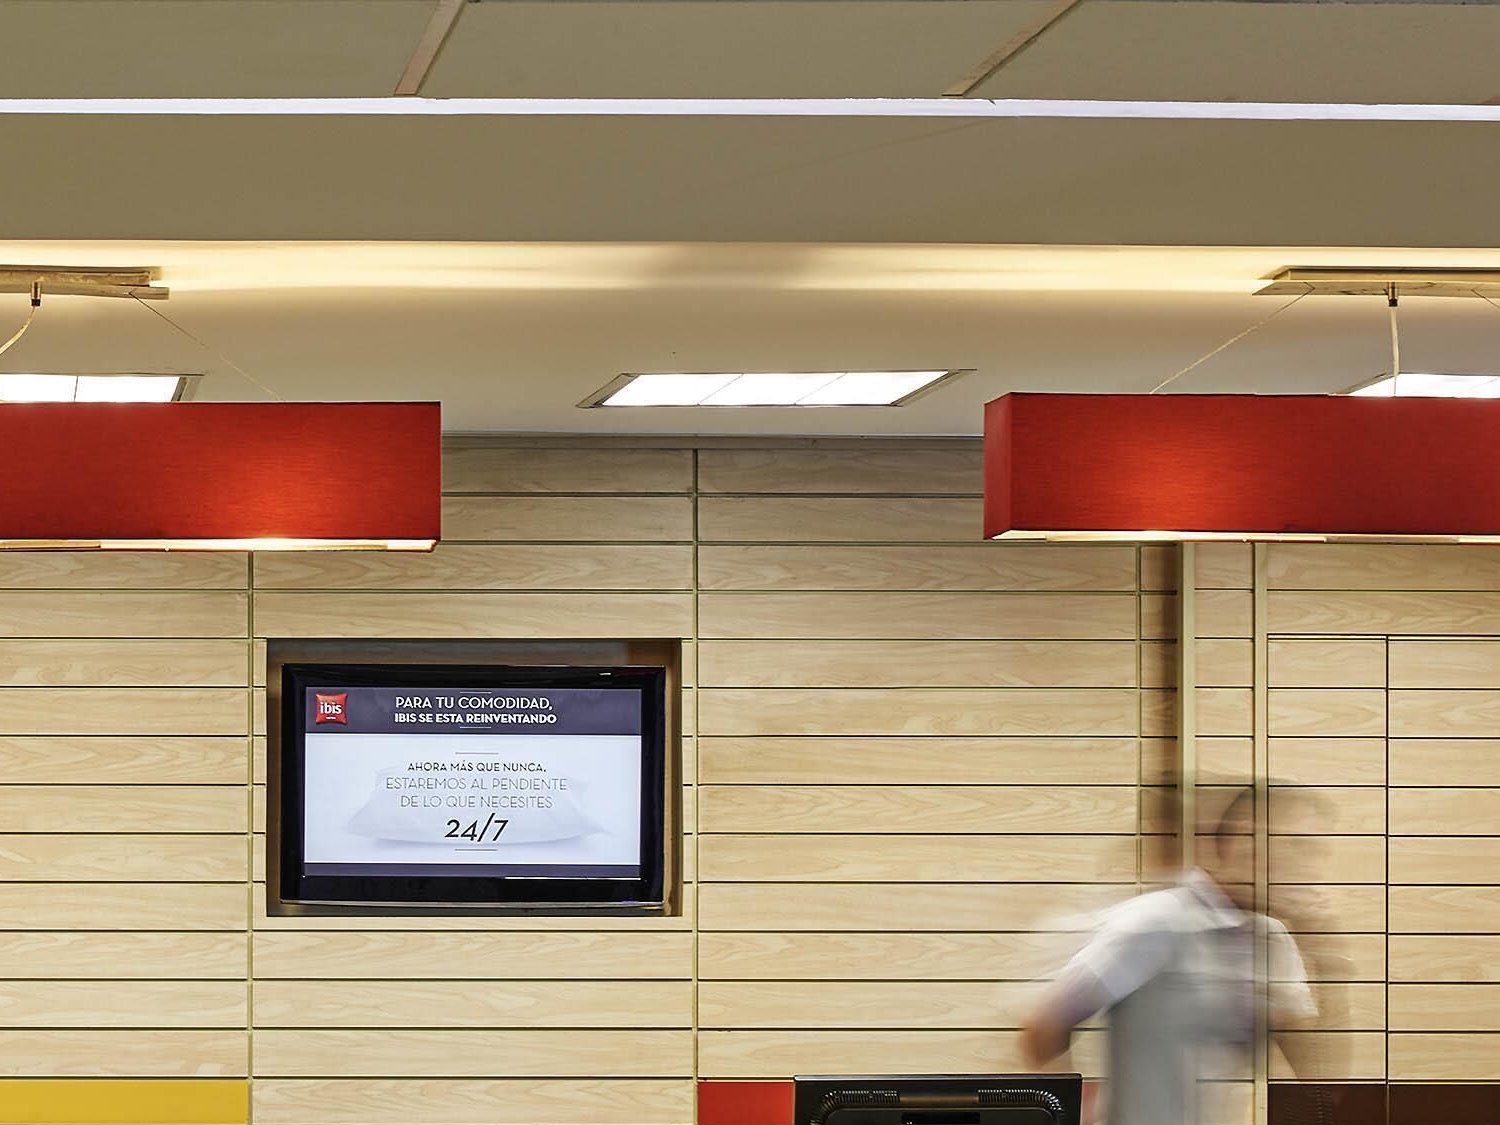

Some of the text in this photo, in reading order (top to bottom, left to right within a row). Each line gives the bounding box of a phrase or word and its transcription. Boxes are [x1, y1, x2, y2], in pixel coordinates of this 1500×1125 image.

[320, 702, 342, 715] ibis
[396, 696, 552, 711] PARA TU COMODIDAD,
[418, 713, 433, 723] SE
[436, 713, 464, 723] ESTA
[466, 713, 557, 724] REINVENTANDO
[408, 762, 447, 772] AHORA
[450, 760, 474, 772] MÁS
[477, 762, 500, 773] QUE
[386, 778, 567, 790] ESTAREMOS AL PENDIENTE
[401, 796, 554, 809] DE LO QUE NECESITES
[444, 812, 509, 843] 24/7
